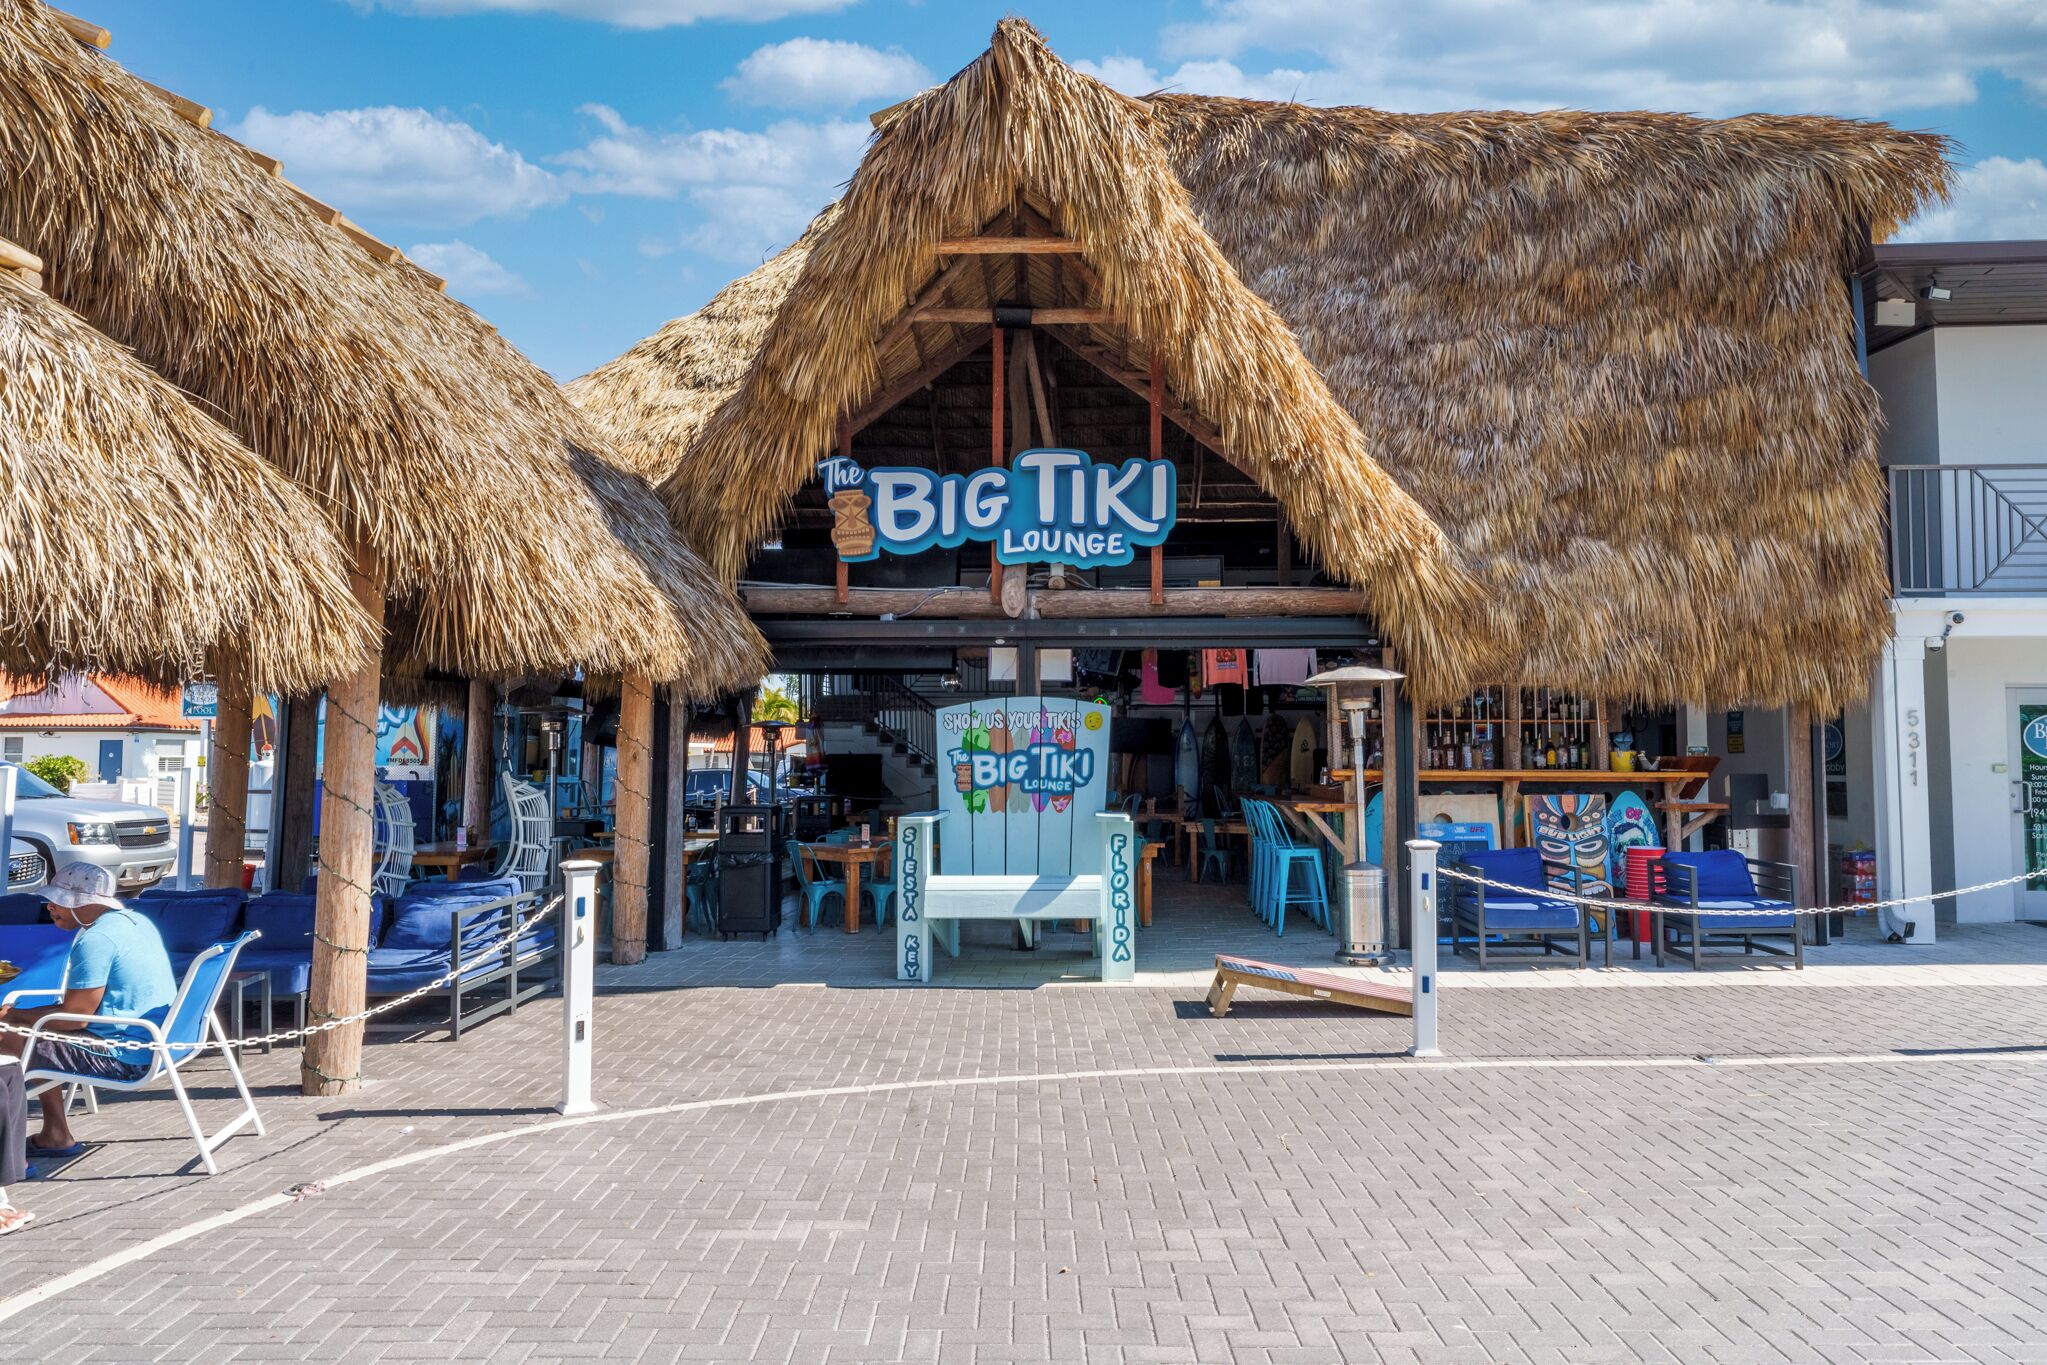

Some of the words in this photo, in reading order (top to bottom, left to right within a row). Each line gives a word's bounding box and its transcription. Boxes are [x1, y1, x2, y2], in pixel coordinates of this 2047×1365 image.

[818, 456, 865, 493] The
[870, 471, 1009, 542] BIG
[1020, 453, 1167, 533] TIKI
[1003, 529, 1126, 557] LOUNGE
[190, 695, 216, 703] RESOR
[943, 711, 982, 735] SHOW
[984, 711, 1005, 731] US
[1006, 711, 1043, 733] YOUR
[1046, 711, 1082, 732] TIKIS
[949, 749, 969, 764] The
[972, 754, 1028, 786] BIG
[1030, 746, 1090, 784] TIKI
[1907, 709, 1921, 787] 5311
[1024, 778, 1072, 791] LOUNGE
[1538, 825, 1568, 840] BUD
[1568, 827, 1603, 841] LIGHT
[902, 826, 919, 921] SIESTA
[1110, 833, 1131, 962] FLORIDA
[904, 934, 920, 978] KEY
